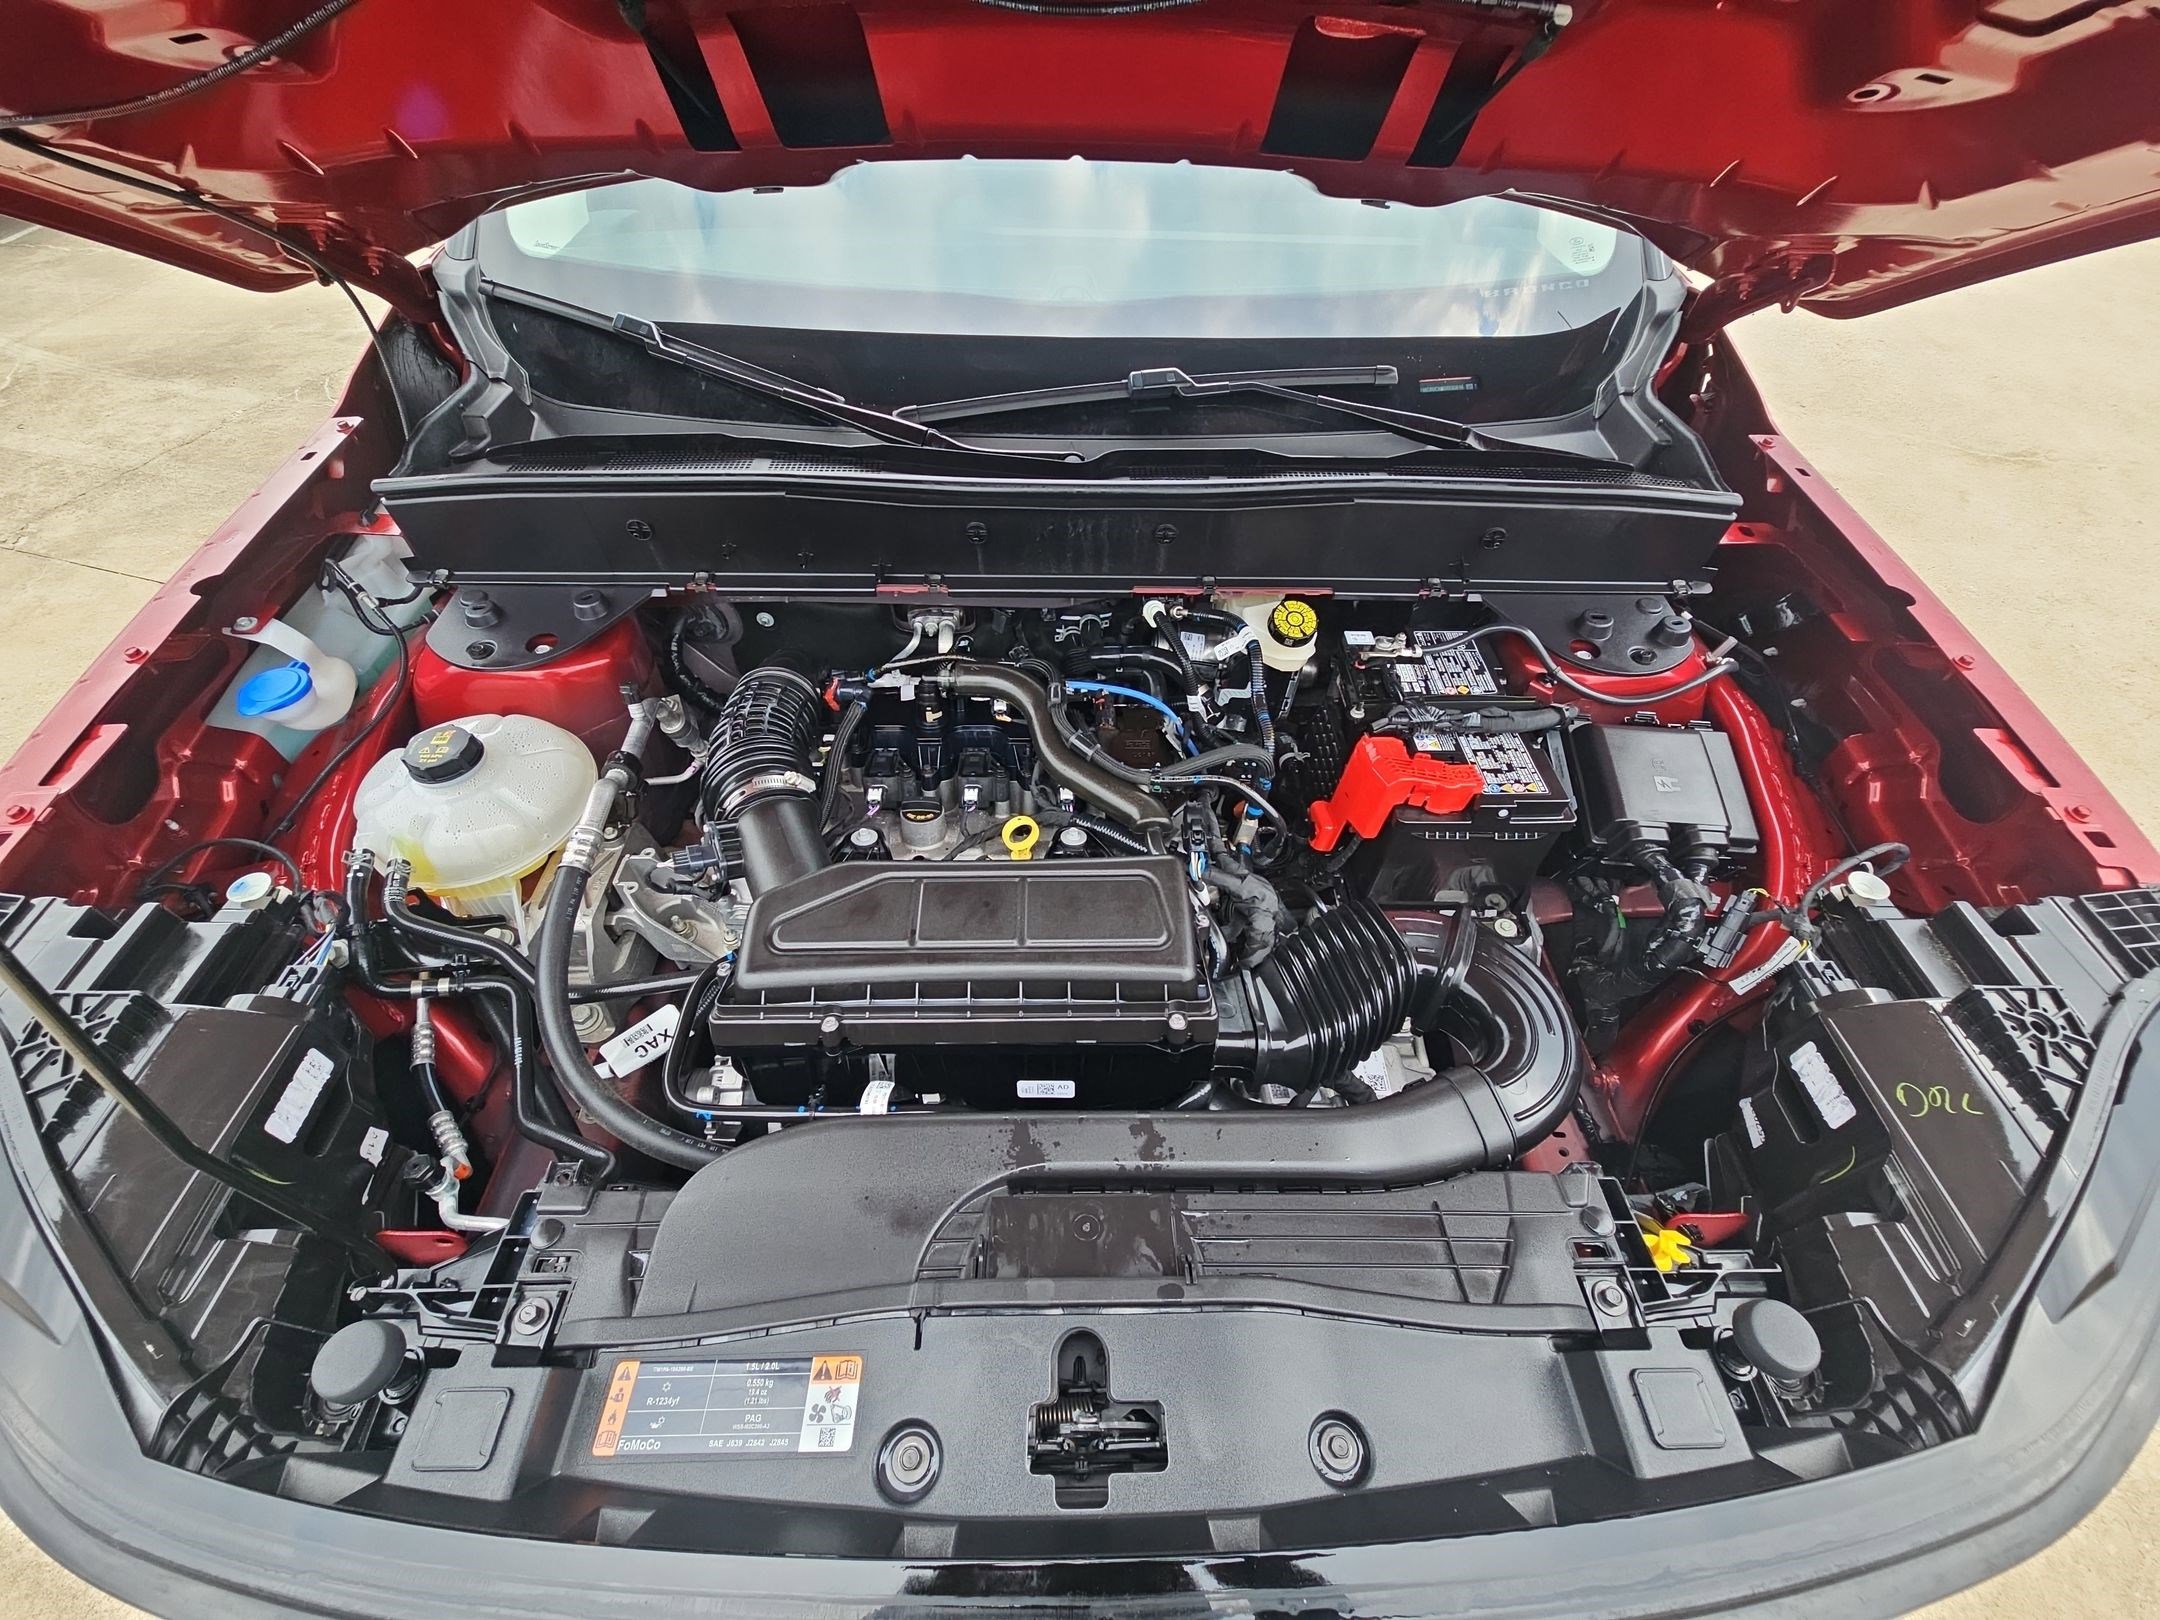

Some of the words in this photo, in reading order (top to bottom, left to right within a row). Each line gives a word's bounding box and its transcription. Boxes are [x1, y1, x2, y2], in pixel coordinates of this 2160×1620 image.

[1484, 279, 1590, 298] BRONCO
[634, 1028, 674, 1058] XAC
[765, 1362, 780, 1371] 2.0L
[746, 1379, 764, 1388] 0.550
[765, 1378, 775, 1389] kg
[646, 1396, 681, 1408] R-1234yf
[744, 1414, 762, 1423] PAG
[616, 1439, 661, 1451] FoMoCo
[708, 1440, 724, 1448] SAE
[726, 1440, 743, 1448] J639
[769, 1439, 790, 1447] J2845
